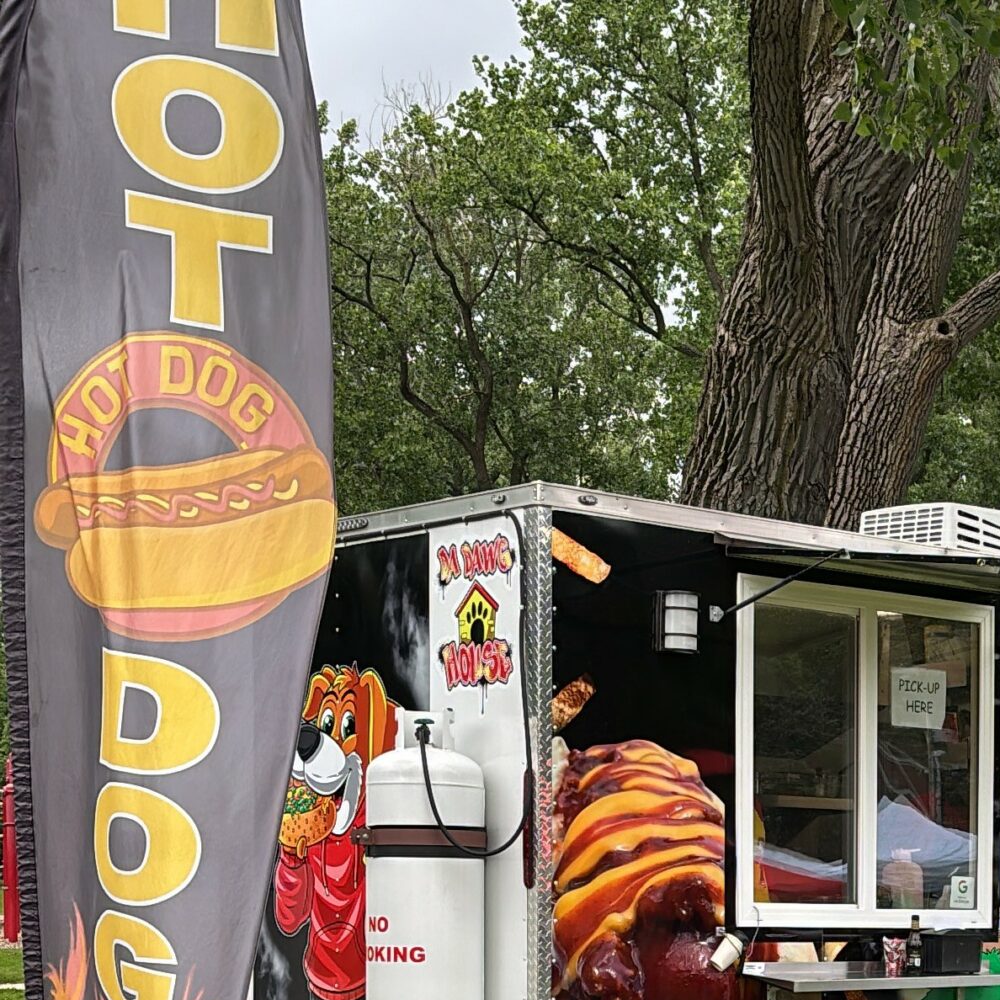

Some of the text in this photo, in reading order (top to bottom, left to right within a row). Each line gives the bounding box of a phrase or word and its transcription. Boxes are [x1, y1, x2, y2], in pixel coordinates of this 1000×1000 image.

[59, 345, 275, 460] HOT DOG
[437, 533, 514, 586] DA DAWG
[441, 639, 513, 691] HOUSE
[898, 679, 940, 694] PICK-UP
[906, 700, 933, 714] HERE
[368, 916, 389, 933] NO
[367, 946, 426, 963] OKING
